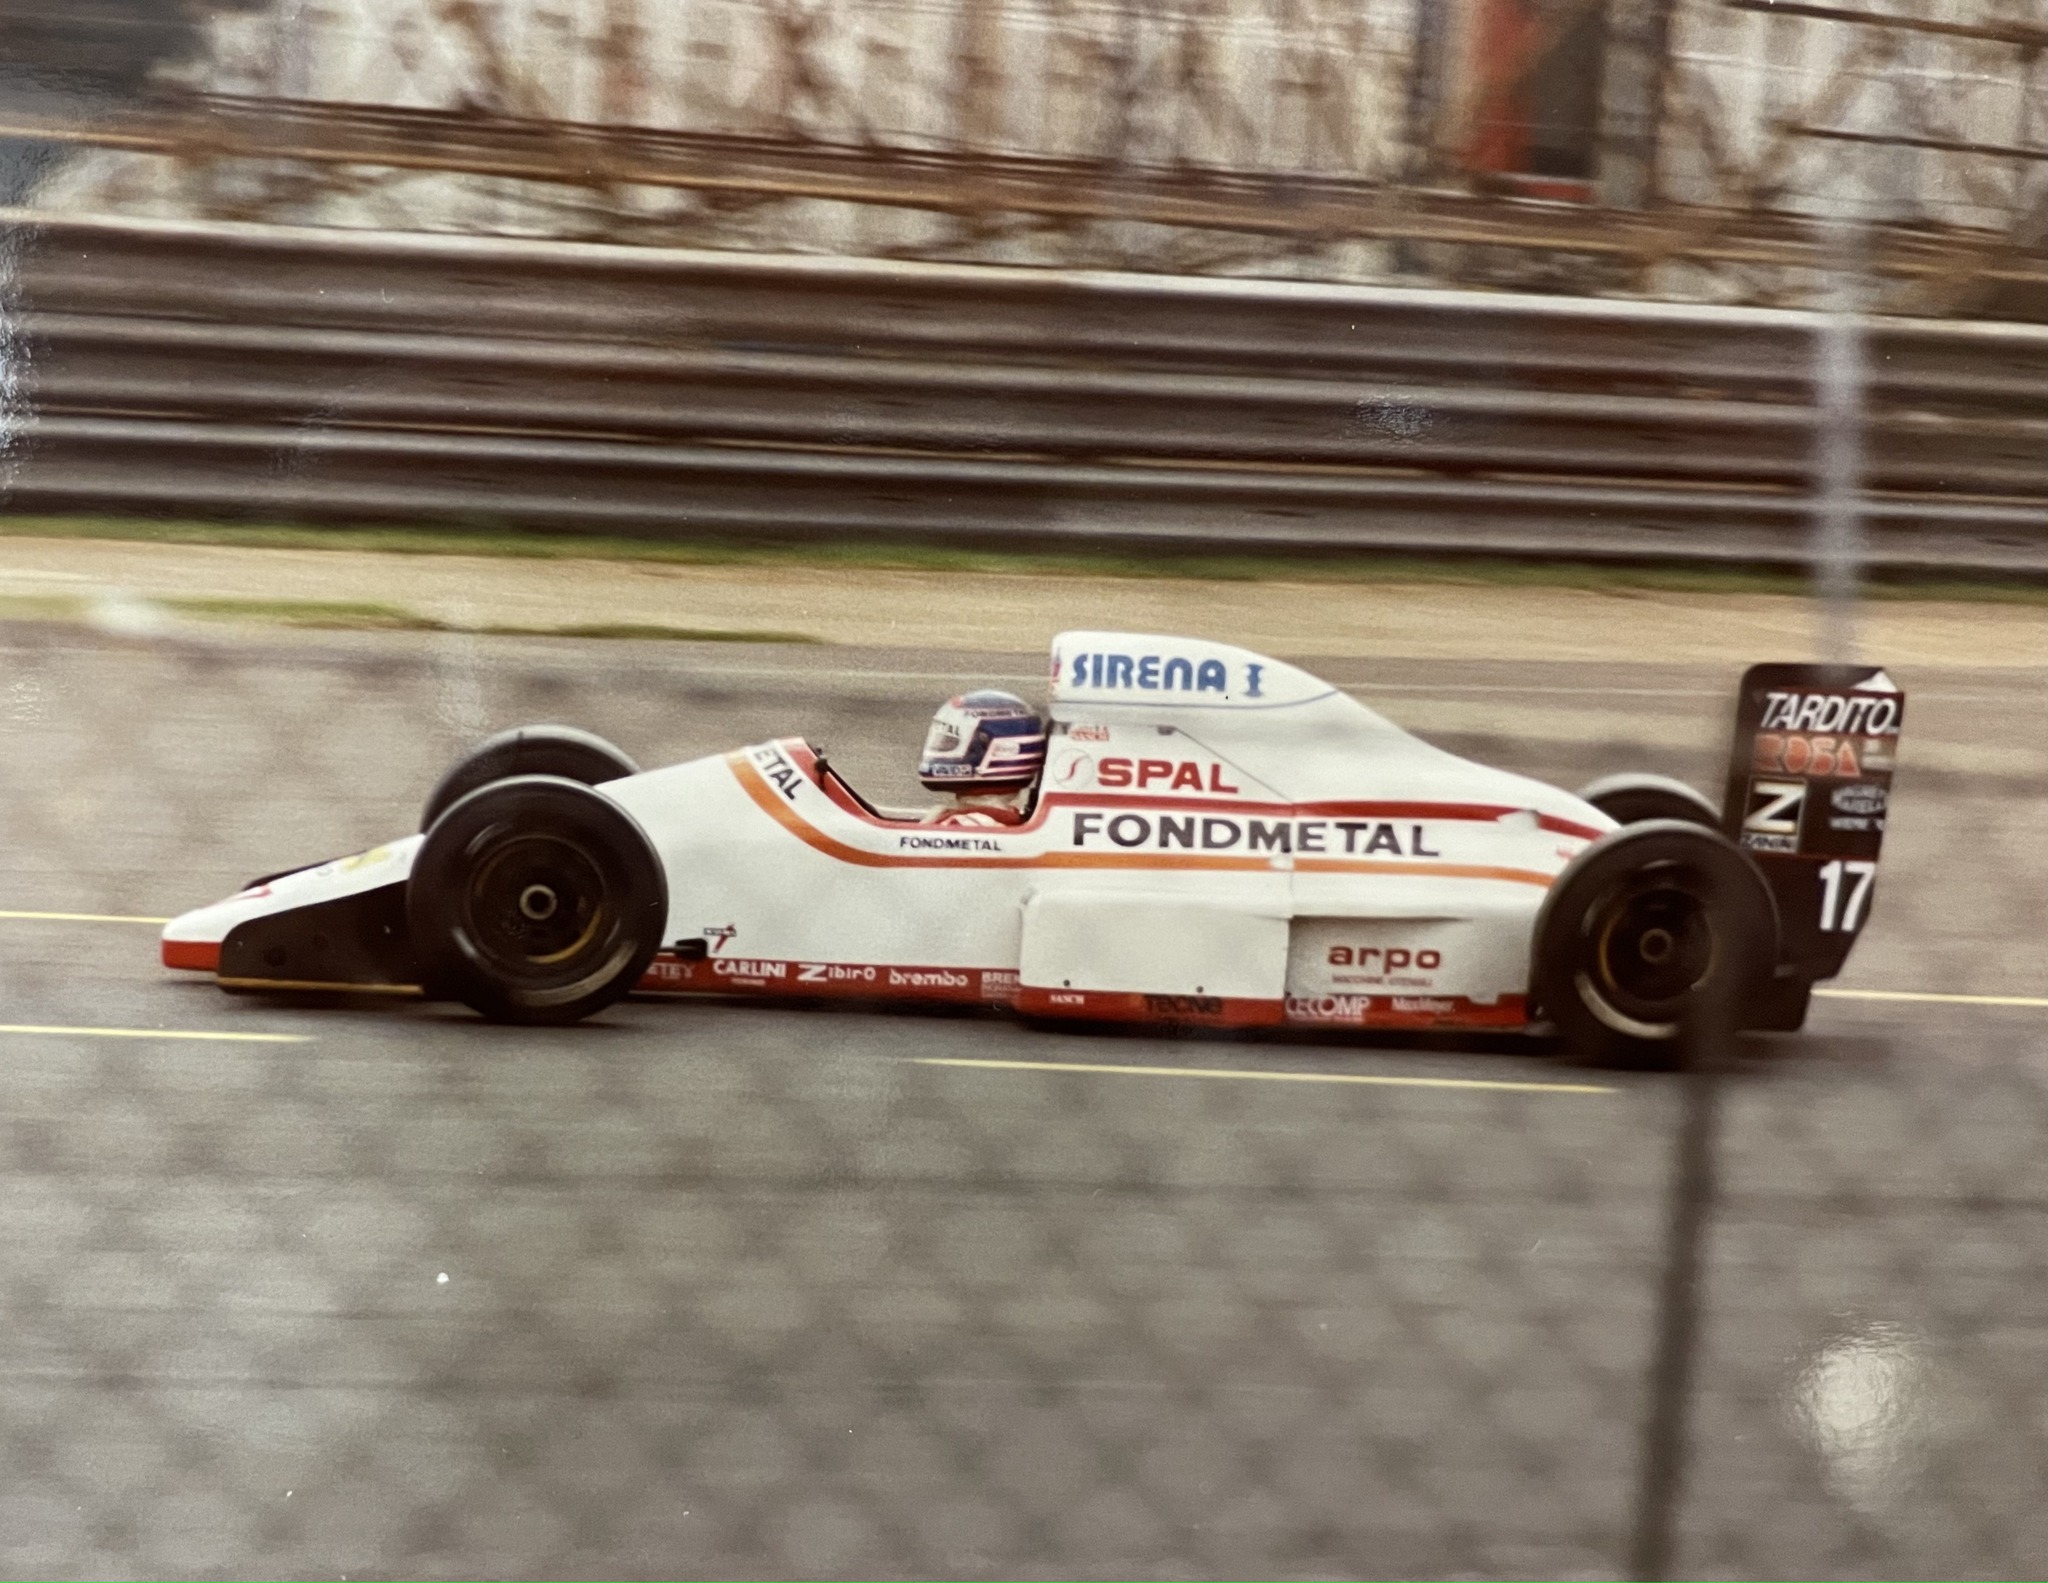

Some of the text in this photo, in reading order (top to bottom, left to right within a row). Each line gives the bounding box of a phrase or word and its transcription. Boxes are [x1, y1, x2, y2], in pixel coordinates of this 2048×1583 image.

[1072, 653, 1227, 692] SIRENA
[1760, 691, 1897, 735] TARDITO
[1097, 757, 1238, 793] SPAL
[900, 836, 1002, 851] FONDMETAL
[1073, 811, 1440, 857] FONDMETAL
[1819, 860, 1876, 932] 17
[713, 959, 787, 978] CARLINI
[889, 968, 968, 986] brembo
[1328, 945, 1441, 974] arpo
